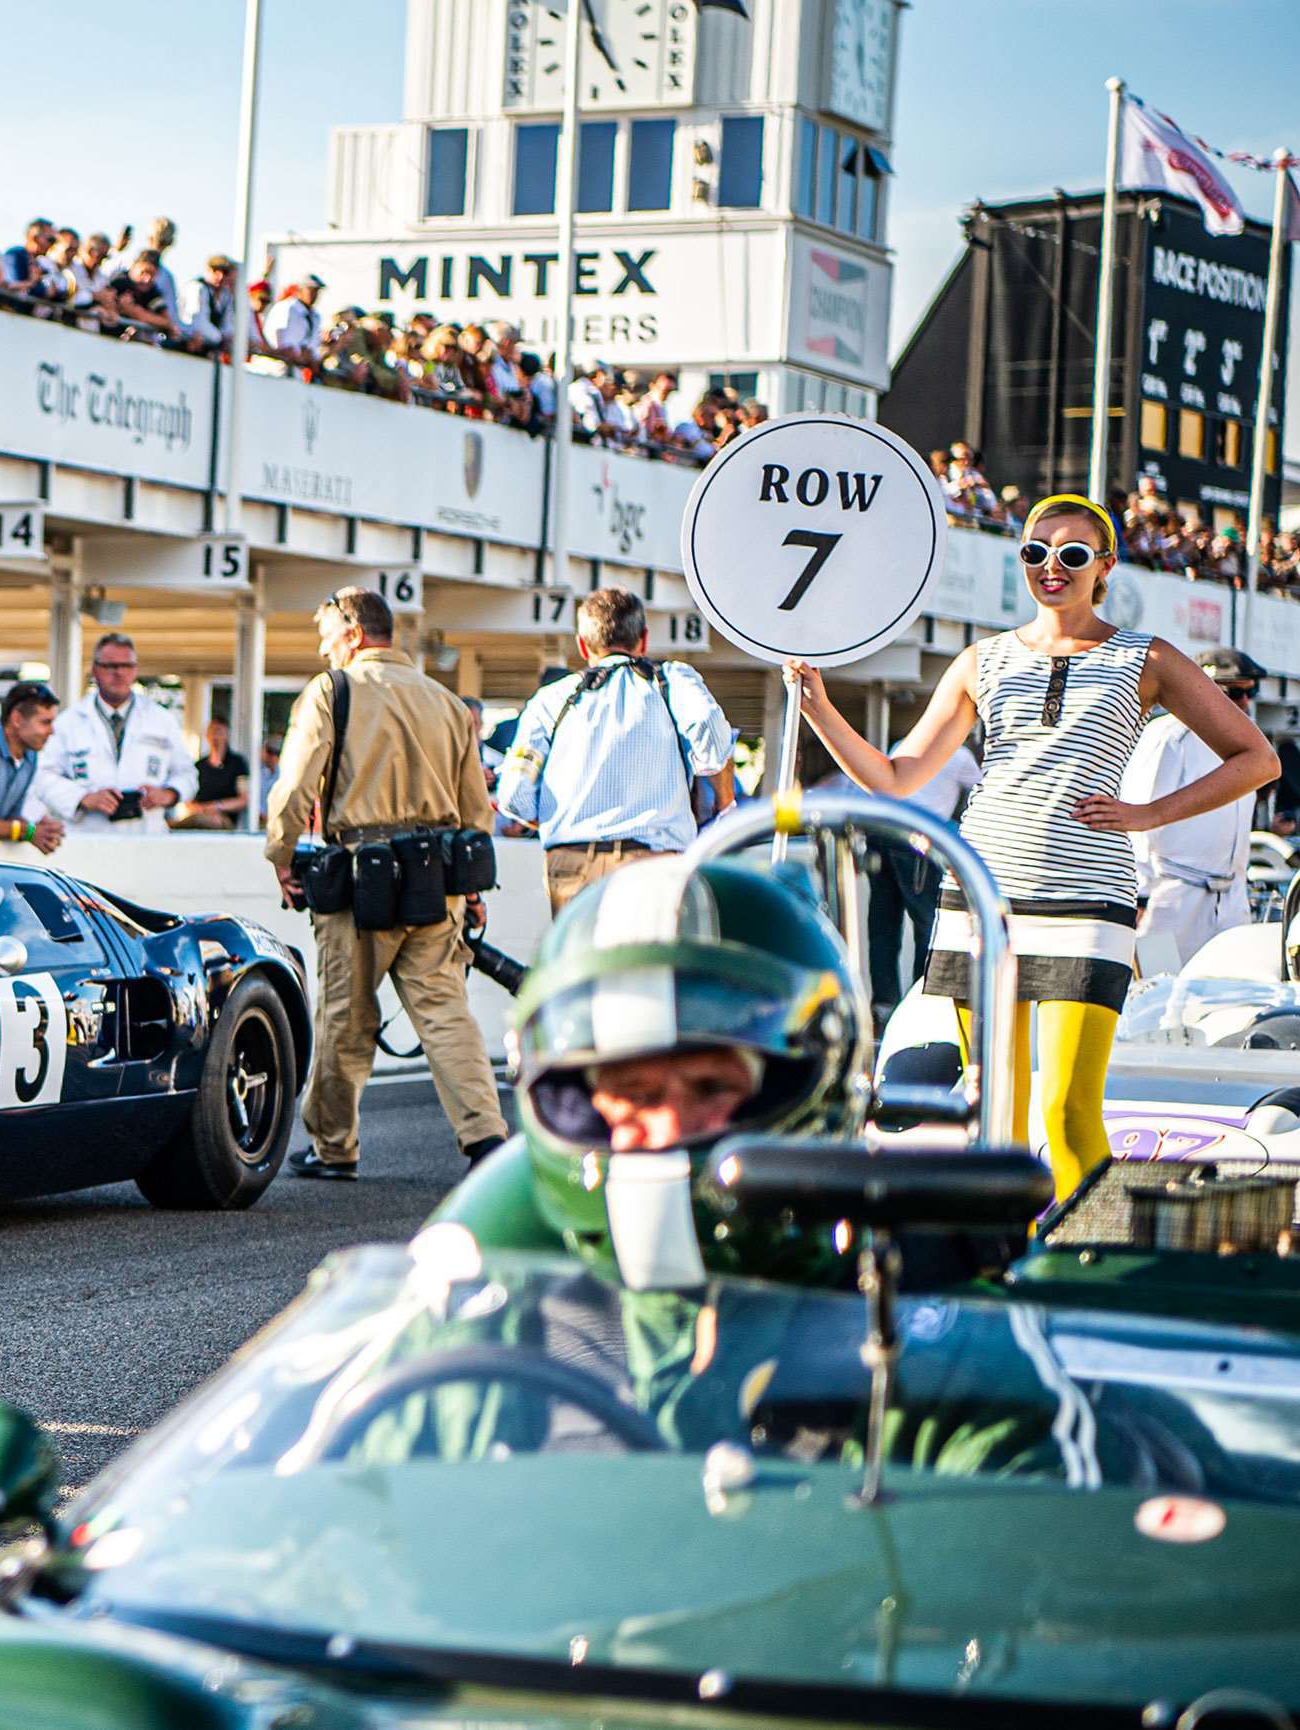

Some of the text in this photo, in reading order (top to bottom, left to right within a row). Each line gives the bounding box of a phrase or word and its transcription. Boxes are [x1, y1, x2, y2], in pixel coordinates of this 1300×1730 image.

[380, 249, 658, 300] MINTEX
[1153, 245, 1197, 293] RACE
[37, 361, 192, 453] The Telegraph
[759, 463, 884, 513] ROW
[203, 544, 241, 578] 15
[777, 528, 844, 611] 7
[379, 571, 414, 603] 16
[533, 592, 567, 623] 17
[670, 613, 702, 642] 18
[12, 980, 50, 1103] 3
